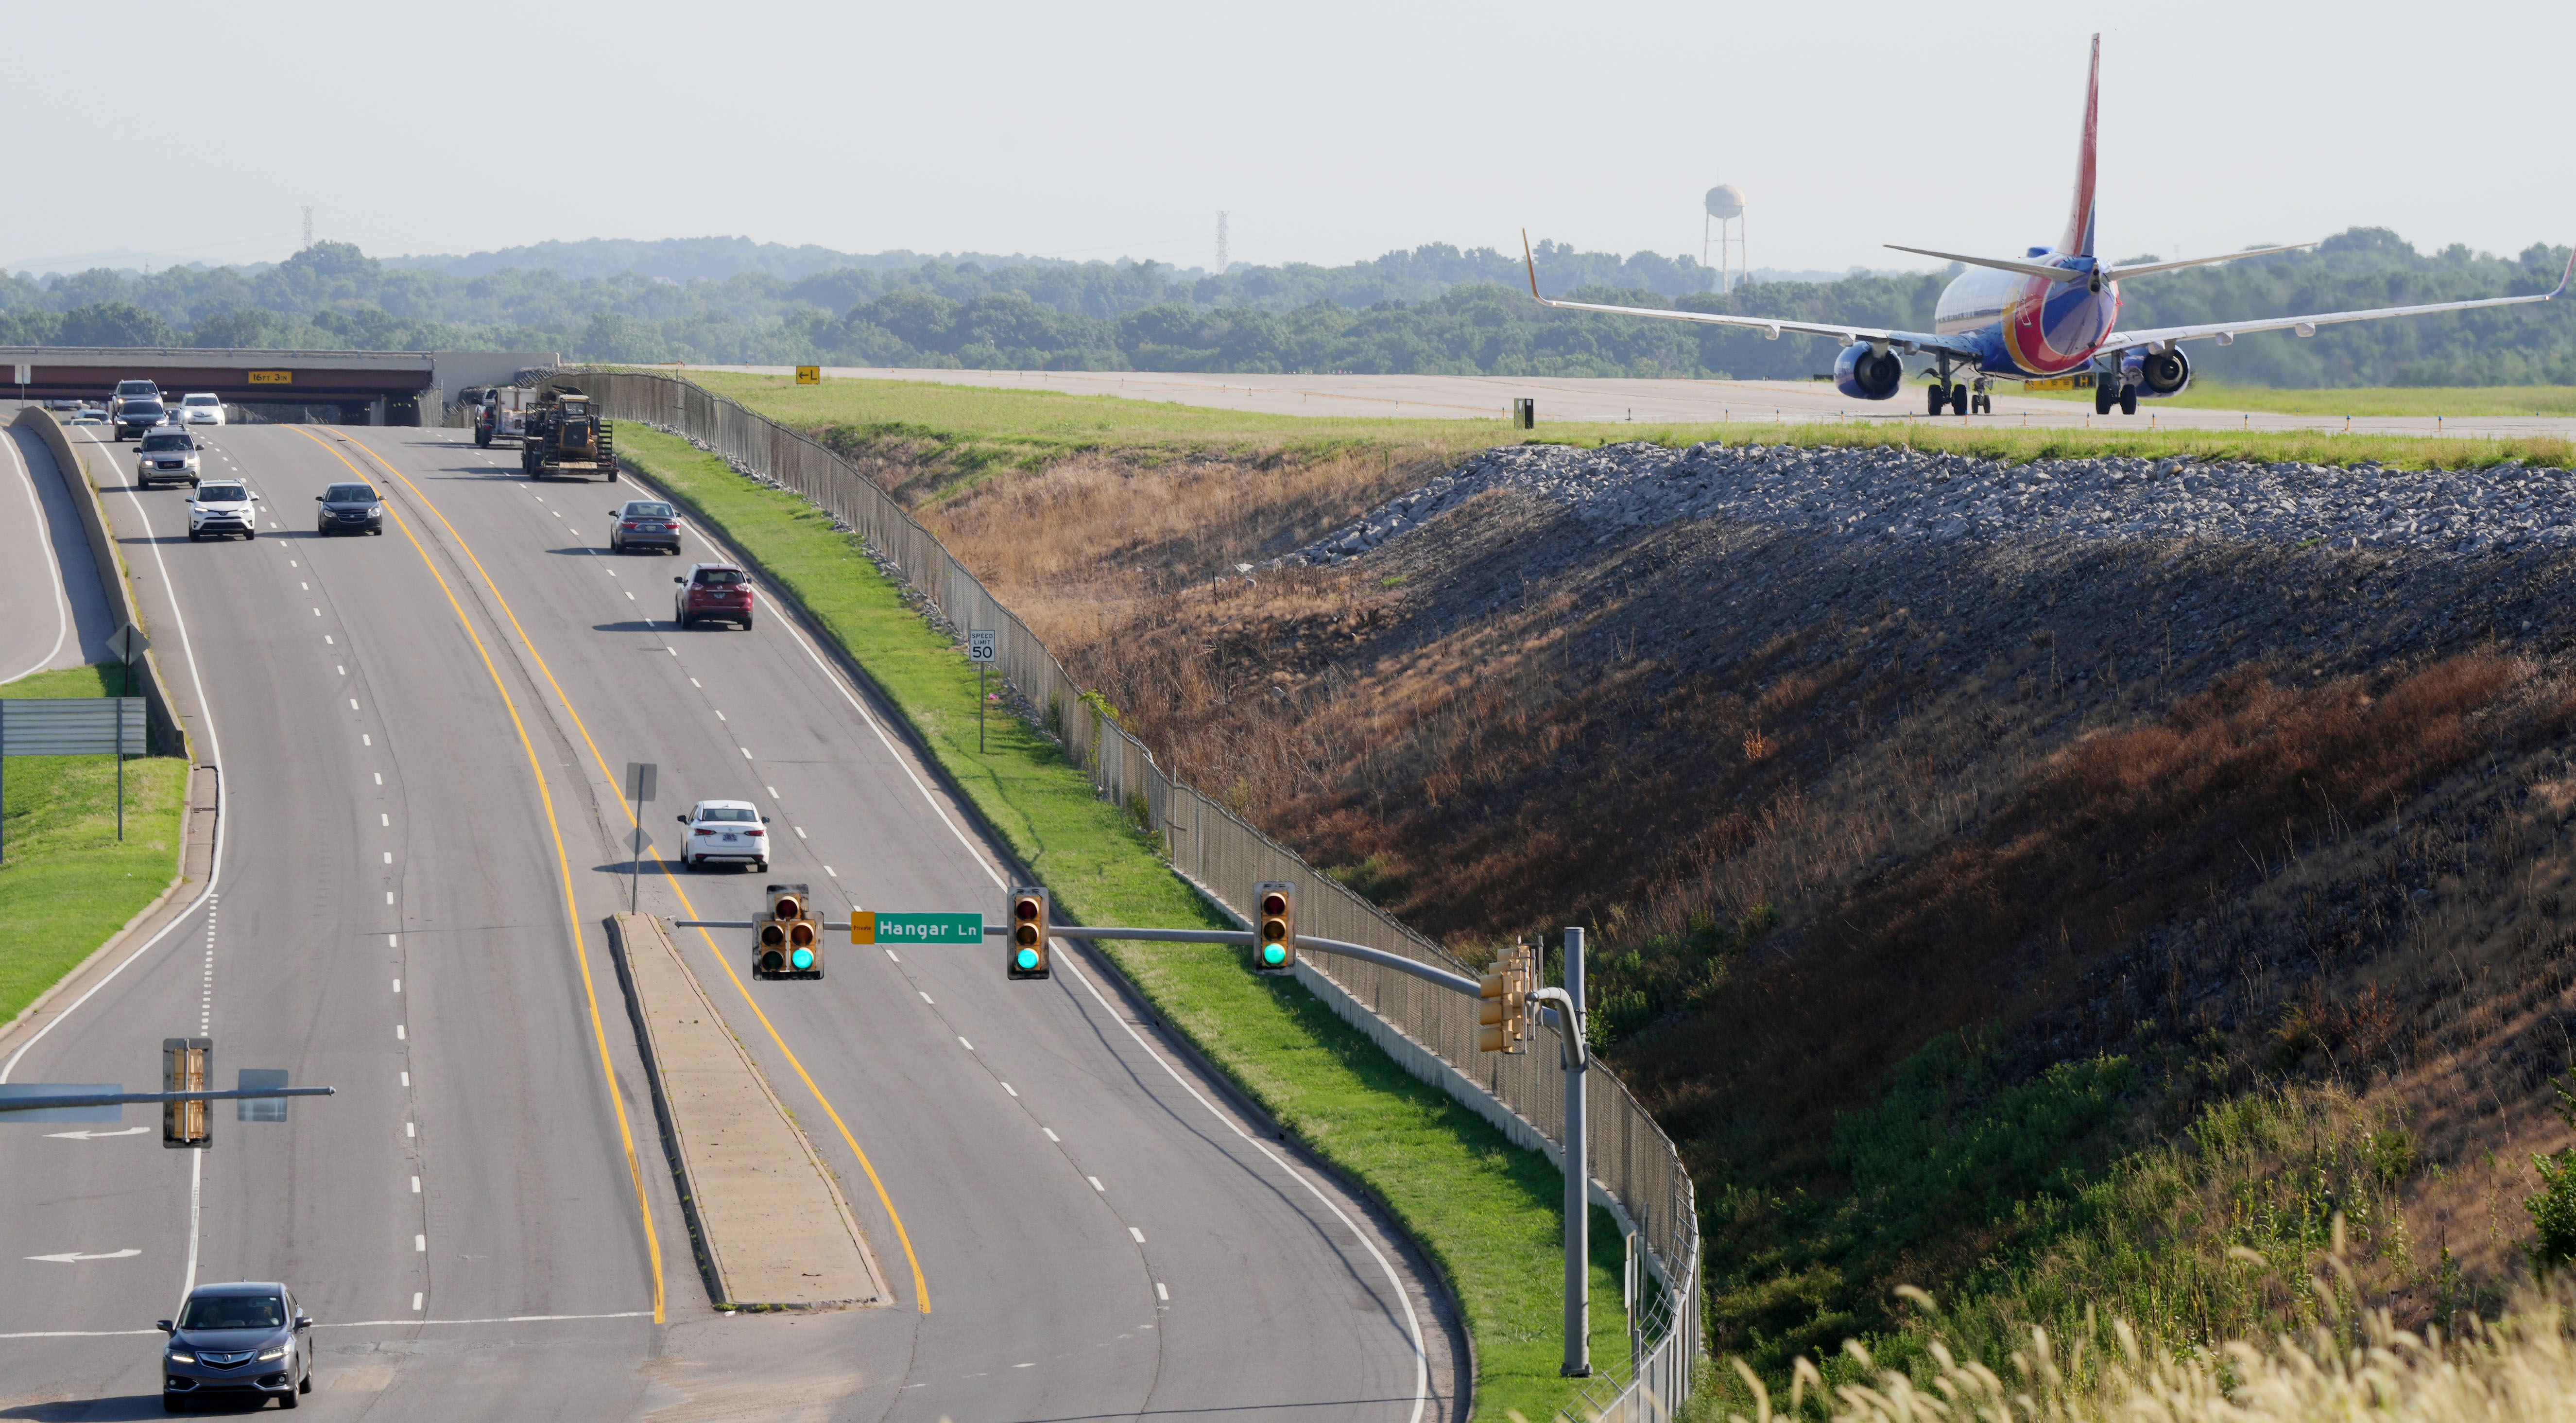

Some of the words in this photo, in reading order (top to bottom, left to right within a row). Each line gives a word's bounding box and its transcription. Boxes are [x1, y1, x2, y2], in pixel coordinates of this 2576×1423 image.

[810, 370, 817, 380] L
[973, 646, 992, 659] 50
[880, 921, 949, 940] Hangar
[958, 924, 977, 936] Ln
